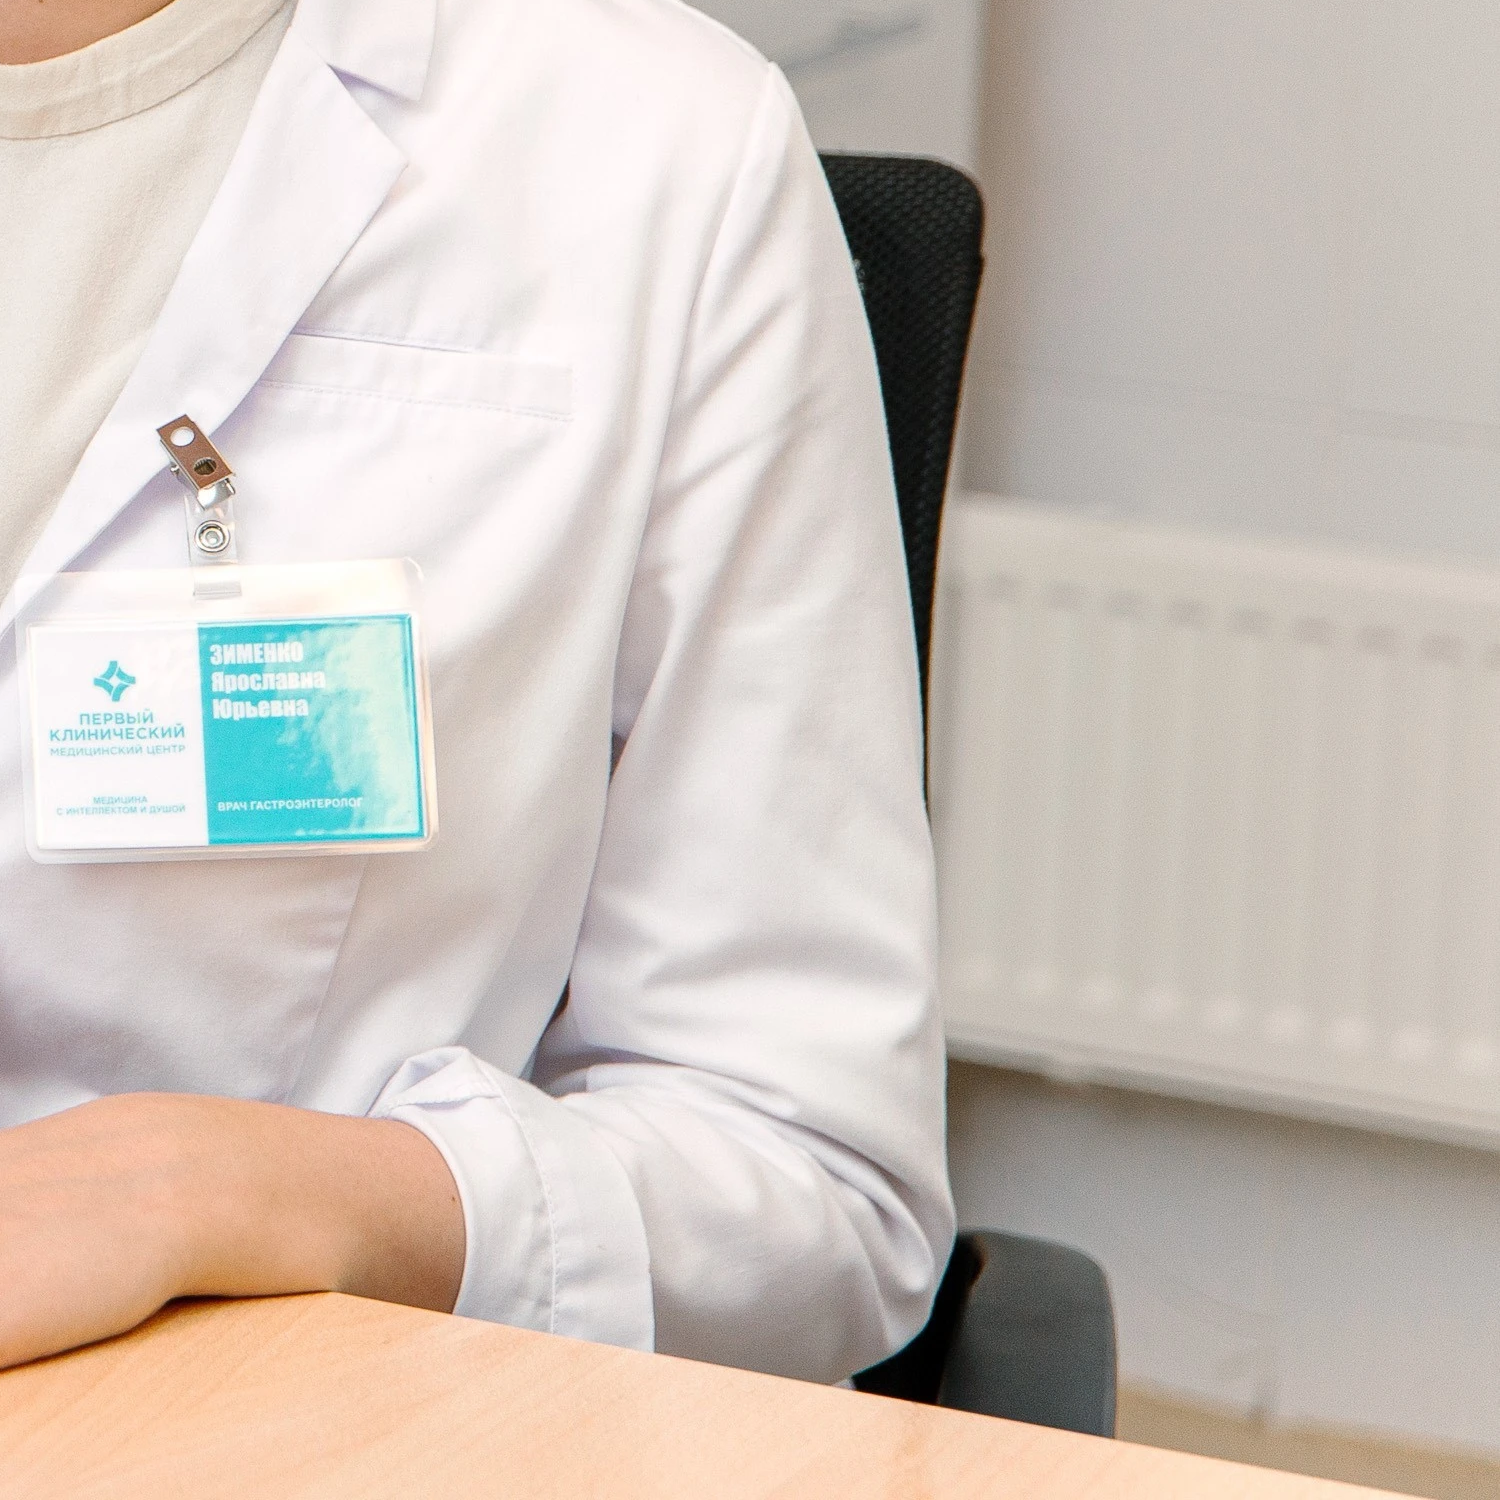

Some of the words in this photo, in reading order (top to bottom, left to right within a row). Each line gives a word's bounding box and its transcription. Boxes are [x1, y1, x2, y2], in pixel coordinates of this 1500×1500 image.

[209, 641, 303, 665] ЗИМЕНКО
[211, 671, 325, 694] Ярославна
[79, 708, 154, 726] ПЕРВЫЙ
[212, 698, 309, 721] Юрьевна
[49, 723, 186, 742] КЛИНИЧЕСКИЙ
[49, 745, 143, 757] МЕДИЦИНСКИЙ
[146, 744, 186, 756] ЦЕНТР
[92, 795, 148, 805] МЕДИЦИНА
[217, 801, 248, 812] ВРАЧ
[250, 797, 363, 811] ГАСТРОЭНТЕРОЛОГ
